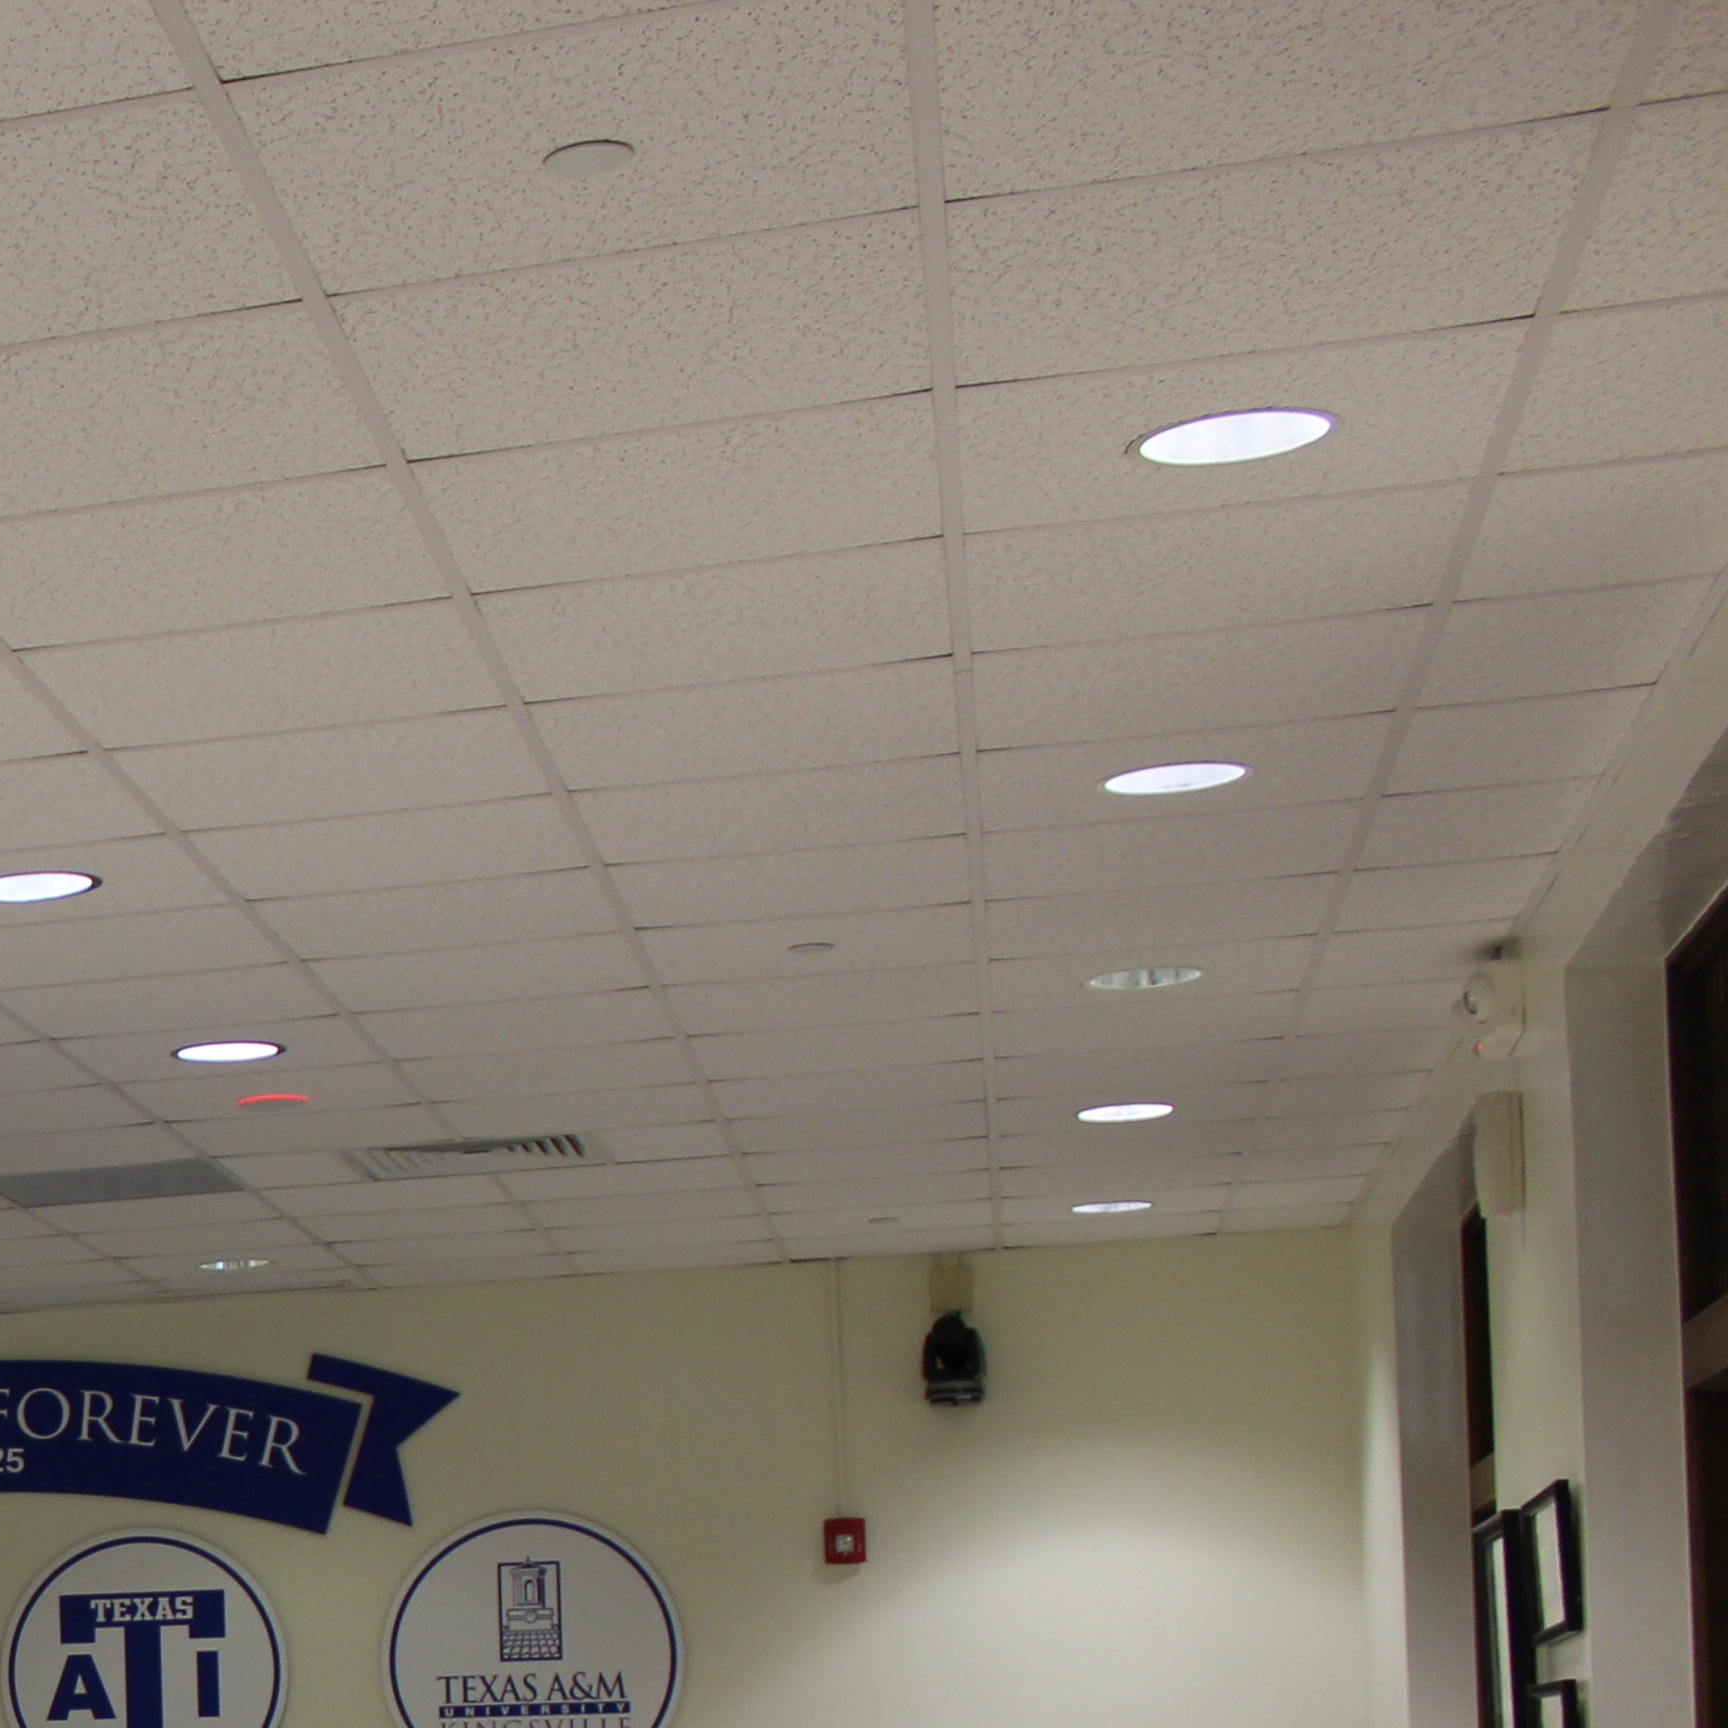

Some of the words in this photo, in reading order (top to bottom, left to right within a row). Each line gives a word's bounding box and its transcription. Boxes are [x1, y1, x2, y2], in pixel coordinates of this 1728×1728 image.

[90, 1595, 194, 1623] TEXAS
[437, 1673, 539, 1704] TEXAS
[546, 1670, 627, 1701] A&M
[444, 1702, 627, 1717] UNIVERSITY
